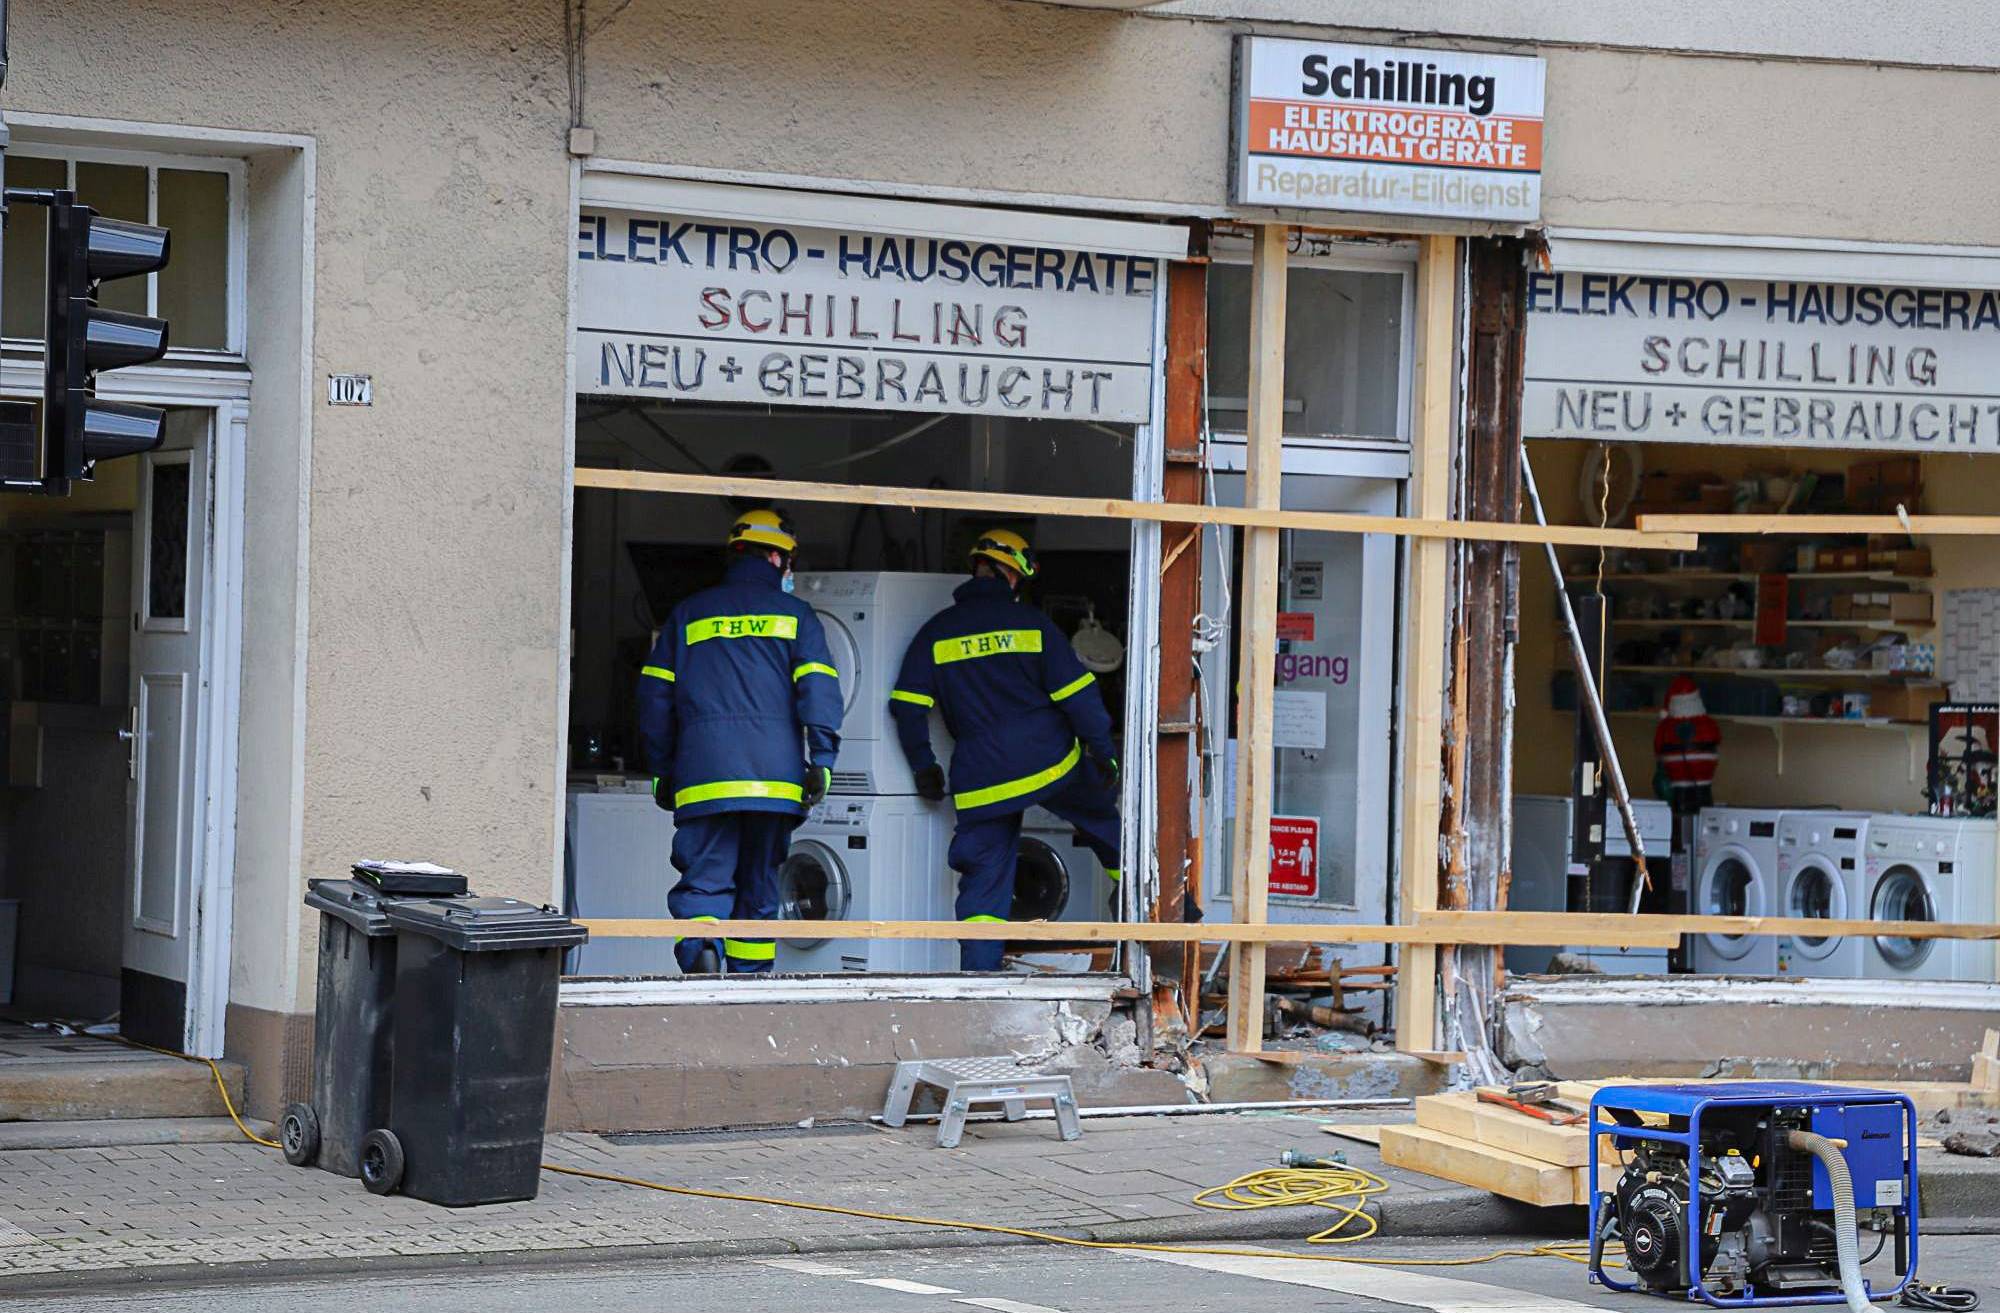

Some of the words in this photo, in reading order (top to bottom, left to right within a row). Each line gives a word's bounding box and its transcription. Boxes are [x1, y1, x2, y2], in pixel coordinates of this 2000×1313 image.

[1302, 54, 1496, 116] Schilling
[1284, 105, 1513, 142] ELEKTROGERÄTE
[1268, 128, 1527, 166] HAUSHALTGERÄTE
[1257, 163, 1531, 208] Reparatur-Eildienst
[578, 215, 799, 274] ELEKTRO
[698, 286, 1028, 347] SCHILLING
[1528, 271, 1730, 320] ELEKTRO
[1766, 283, 2000, 331] HAUSGERA
[601, 341, 707, 392] NEU
[758, 352, 1113, 414] GEBRAUCHT
[1641, 335, 1938, 386] SCHILLING
[336, 378, 366, 402] 107
[1555, 388, 1652, 432] NEU
[712, 619, 768, 635] THW
[961, 634, 1013, 655] THW
